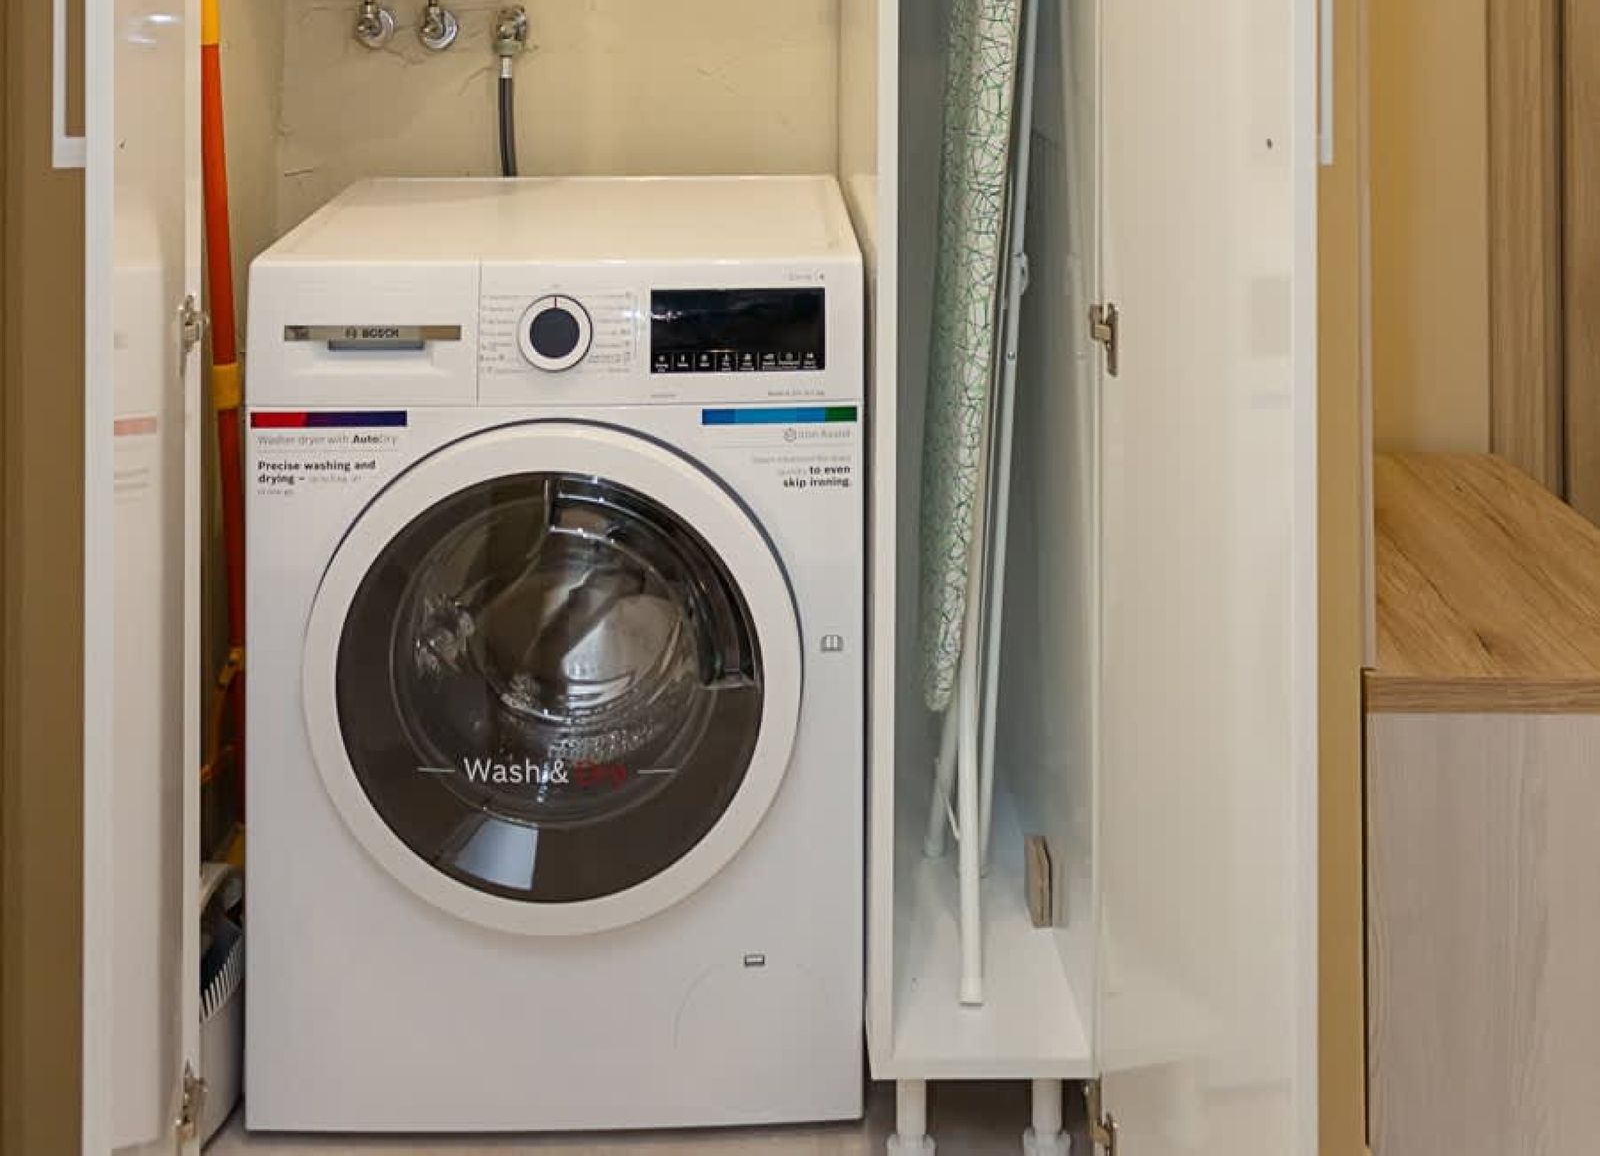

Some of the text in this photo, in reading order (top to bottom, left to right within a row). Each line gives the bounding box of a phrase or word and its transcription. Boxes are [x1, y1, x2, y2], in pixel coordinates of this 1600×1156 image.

[362, 327, 399, 338] BOSCH
[258, 460, 376, 472] Precise washing and
[810, 466, 821, 474] to
[824, 466, 850, 474] even
[258, 474, 295, 485] drying
[783, 477, 806, 488] skip
[463, 757, 539, 783] Wash
[550, 758, 569, 783] &
